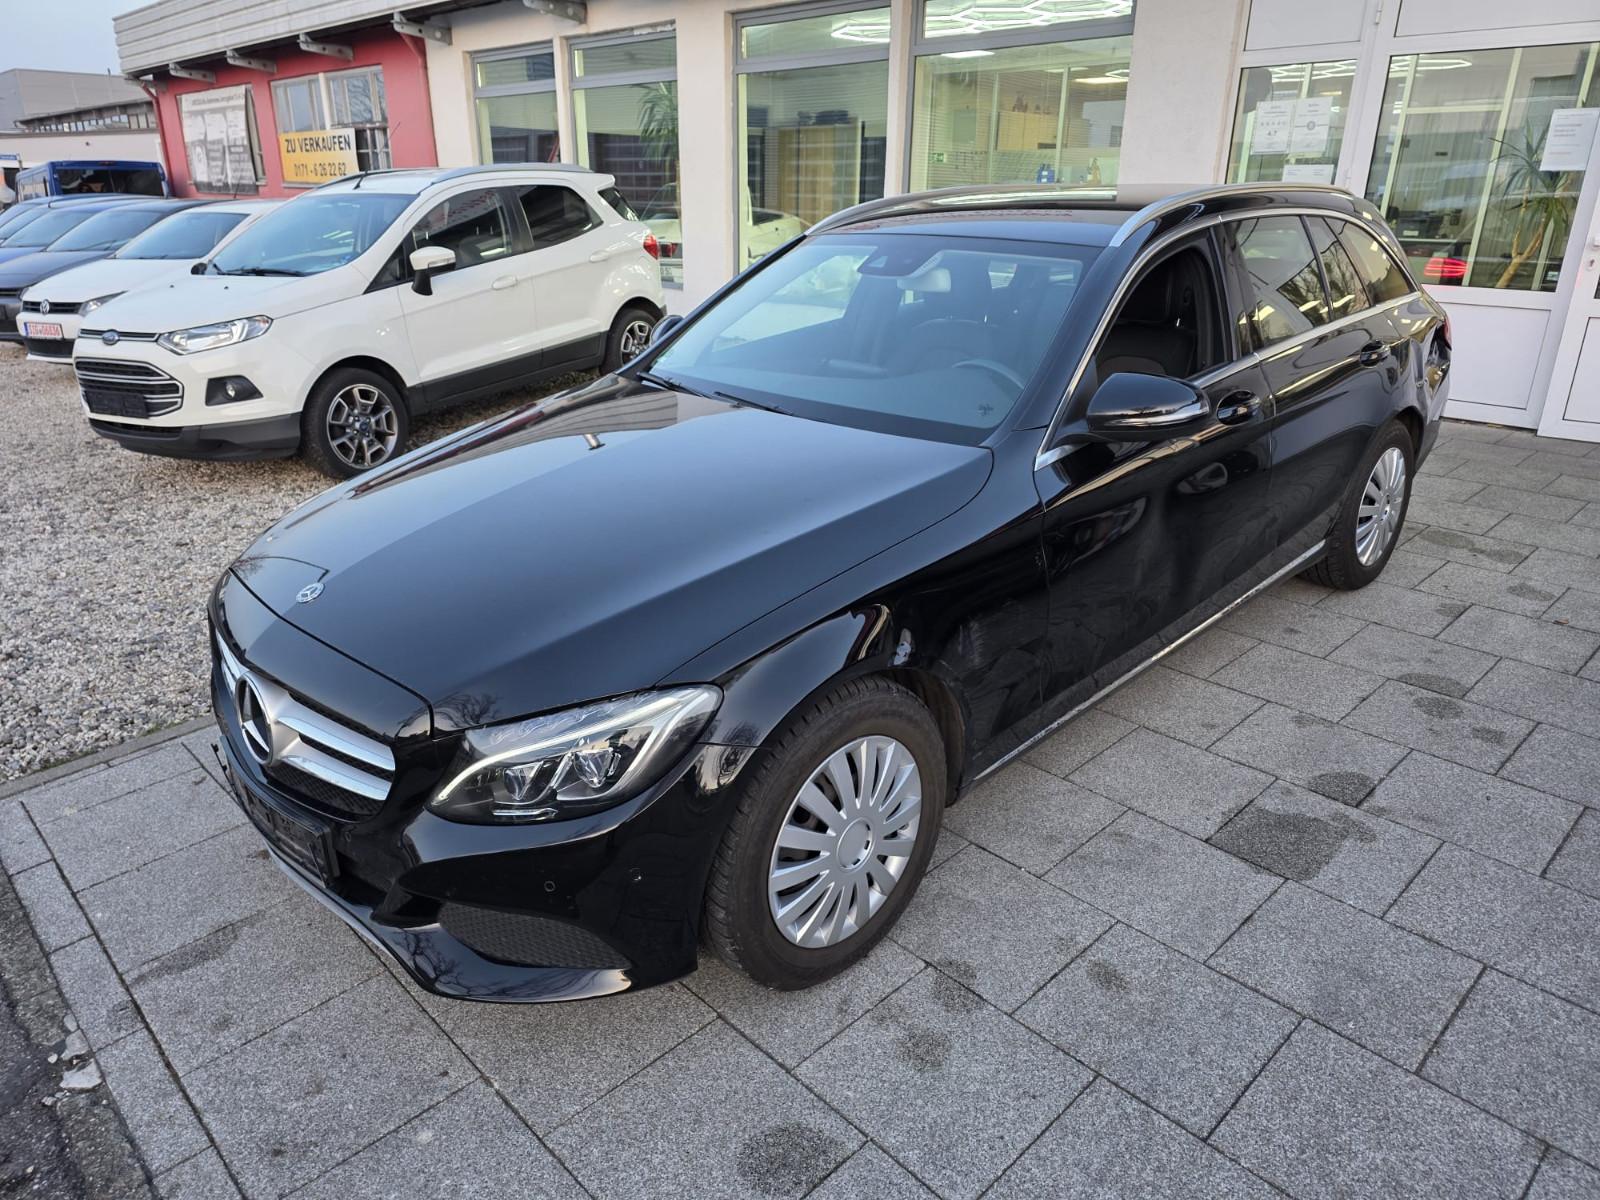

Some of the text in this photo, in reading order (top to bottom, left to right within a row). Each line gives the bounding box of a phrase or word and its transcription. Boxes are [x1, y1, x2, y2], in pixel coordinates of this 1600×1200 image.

[285, 134, 351, 153] ZU VERKAUFEN
[294, 163, 309, 177] 0171
[328, 162, 337, 177] 22
[338, 162, 347, 176] 62
